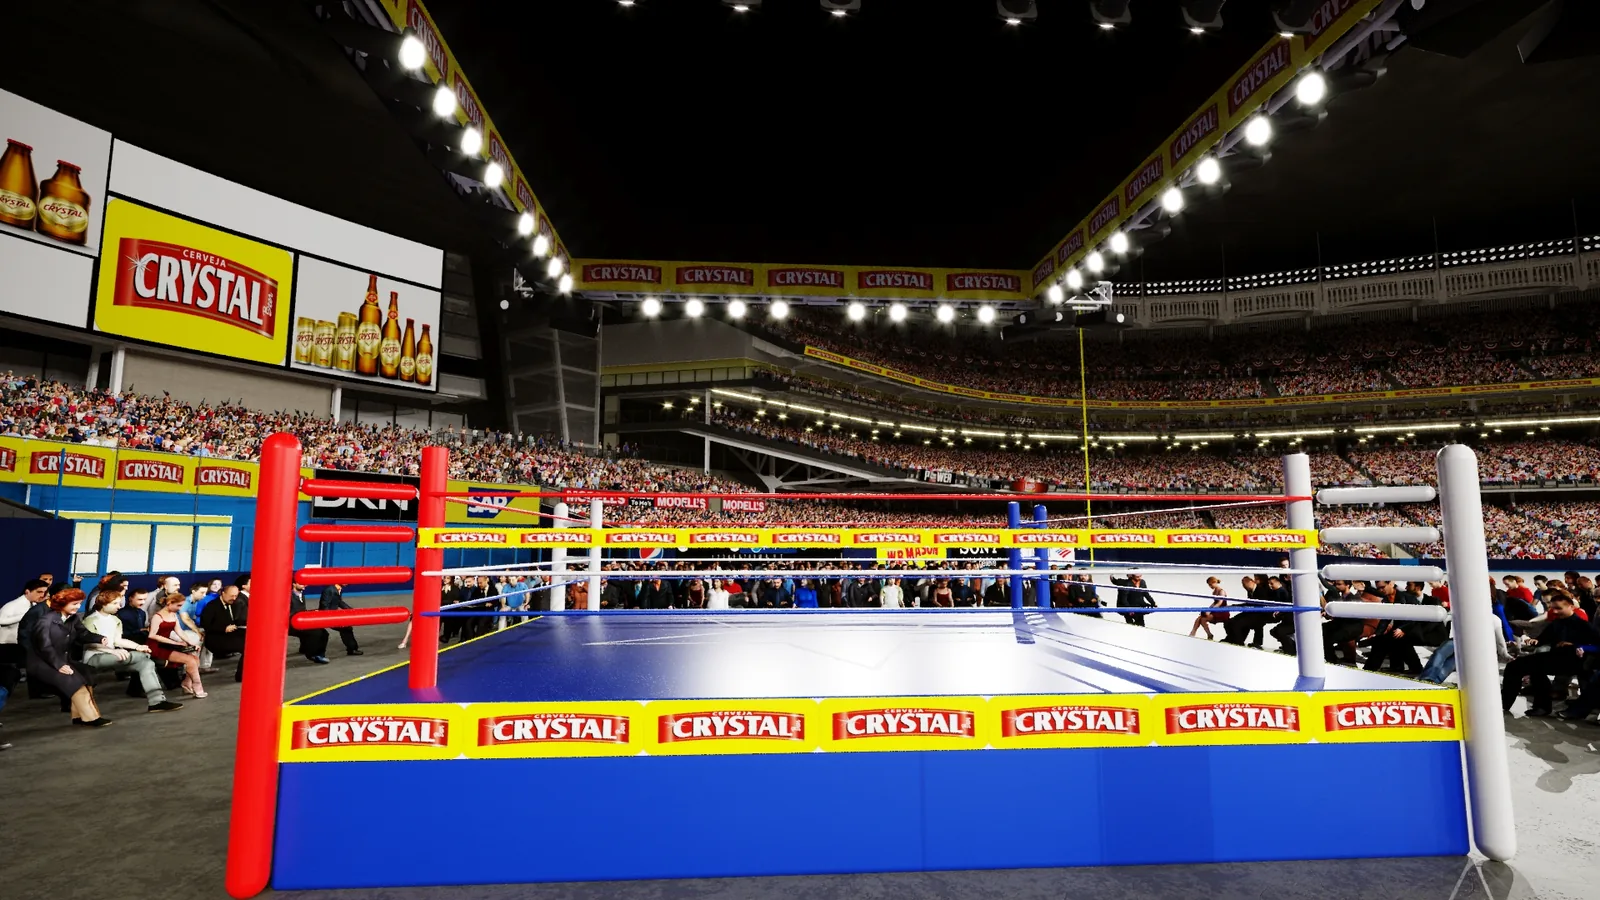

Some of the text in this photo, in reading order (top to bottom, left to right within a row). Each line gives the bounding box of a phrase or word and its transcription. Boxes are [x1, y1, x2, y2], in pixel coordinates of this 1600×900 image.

[1233, 45, 1285, 105] CRYSTAL
[1175, 111, 1214, 159] CRYSTAL
[1128, 161, 1160, 200] CRYSTAL
[0, 197, 30, 208] RYSTAL
[43, 204, 82, 217] CRYSTAL
[182, 249, 226, 268] CERVEJA
[590, 267, 654, 281] CRYSTAL
[684, 269, 747, 283] CRYSTAL
[775, 271, 838, 285] CRYSTAL
[865, 273, 926, 288] CRYSTAL
[134, 252, 263, 326] CRYSTAL
[954, 275, 1014, 290] CRYSTAL
[125, 463, 179, 481] CRYSTAL
[200, 469, 247, 486] CRYSTAL
[657, 496, 706, 510] MODELL'S
[722, 499, 764, 511] MODELL'S
[441, 533, 500, 542] CRYSTAL
[527, 533, 585, 542] CRYSTAL
[612, 533, 669, 542] CRYSTAL
[696, 533, 752, 542] CRYSTAL
[778, 533, 834, 542] CRYSTAL
[860, 533, 914, 542] CRYSTAL
[940, 534, 993, 543] CRYSTAL
[1018, 534, 1072, 543] CRYSTAL
[1097, 534, 1149, 543] CRYSTAL
[1173, 534, 1225, 543] CRYSTAL
[1249, 534, 1299, 543] CRYSTAL
[1015, 710, 1129, 732] CRYSTAL
[1179, 707, 1288, 729] CRYSTAL
[1337, 705, 1445, 727] CRYSTAL
[493, 717, 617, 741] CRYSTAL
[672, 715, 793, 738] CRYSTAL
[846, 712, 964, 735] CRYSTAL
[308, 720, 435, 744] CRYSTAL
